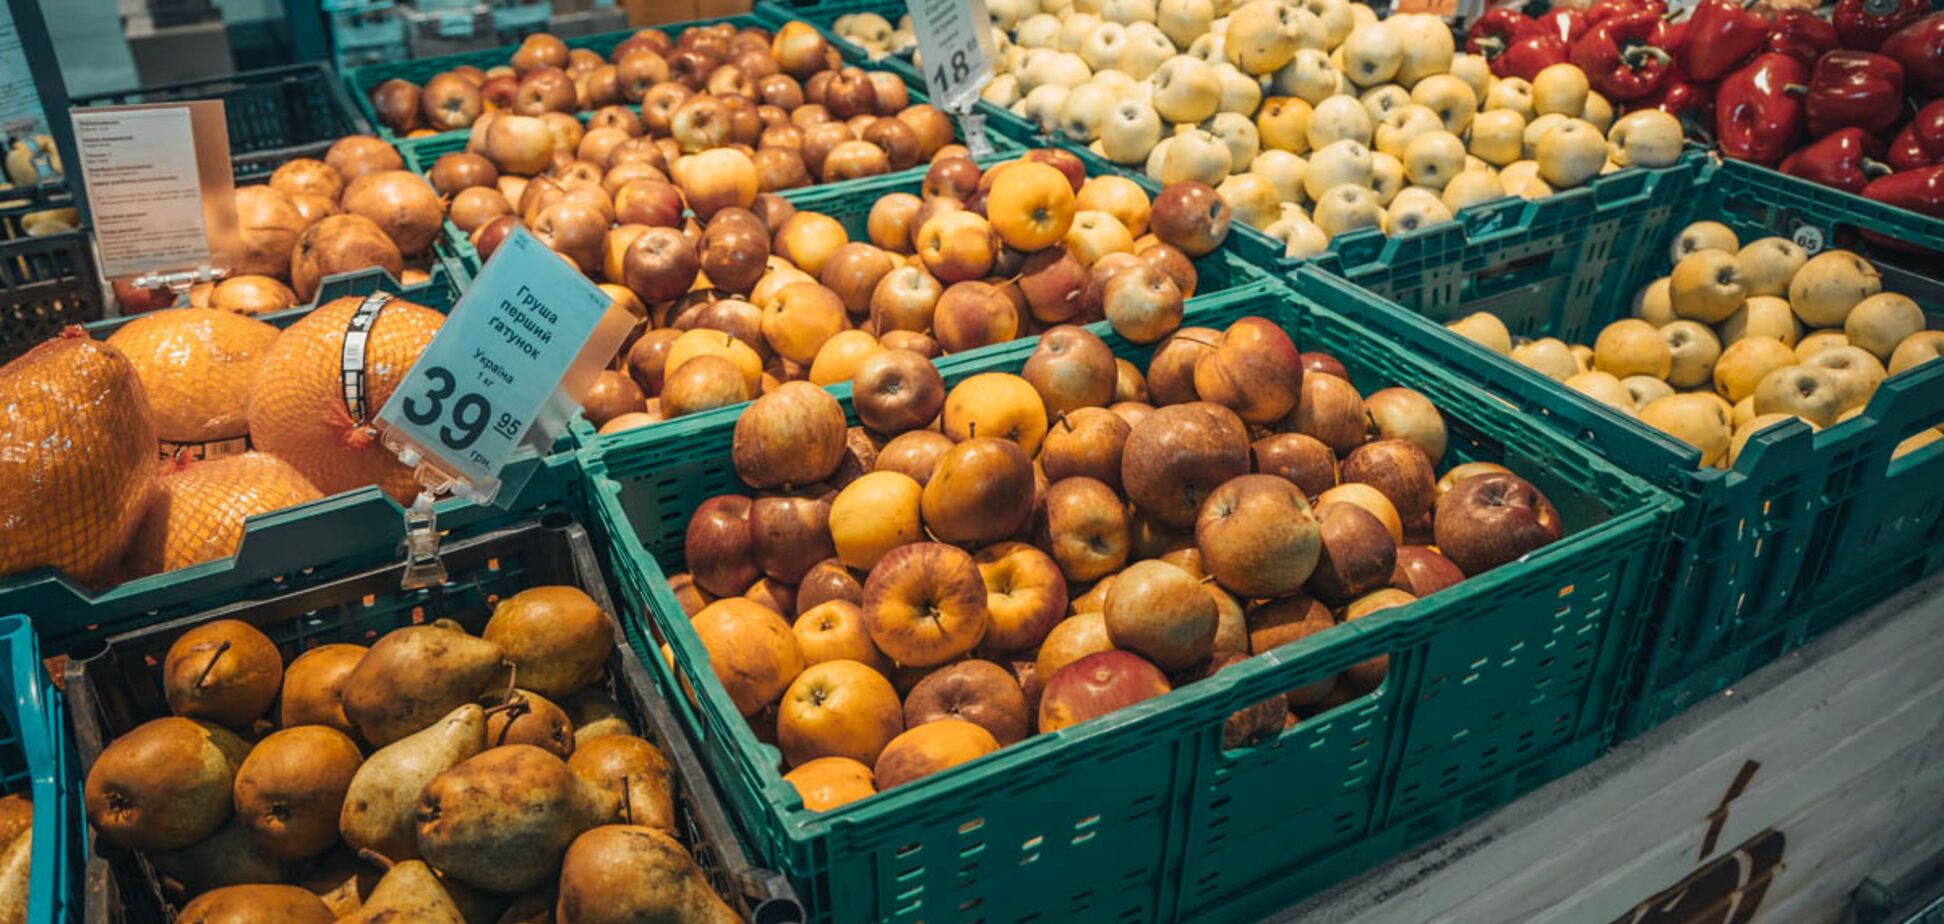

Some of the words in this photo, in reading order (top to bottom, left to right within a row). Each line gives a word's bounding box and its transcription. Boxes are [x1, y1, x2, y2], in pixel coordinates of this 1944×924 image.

[933, 48, 969, 93] 18
[1797, 234, 1818, 251] 65
[499, 299, 553, 345] перший
[516, 284, 559, 325] Груша
[472, 347, 515, 385] Україна
[402, 365, 492, 450] 39
[497, 412, 522, 436] 95
